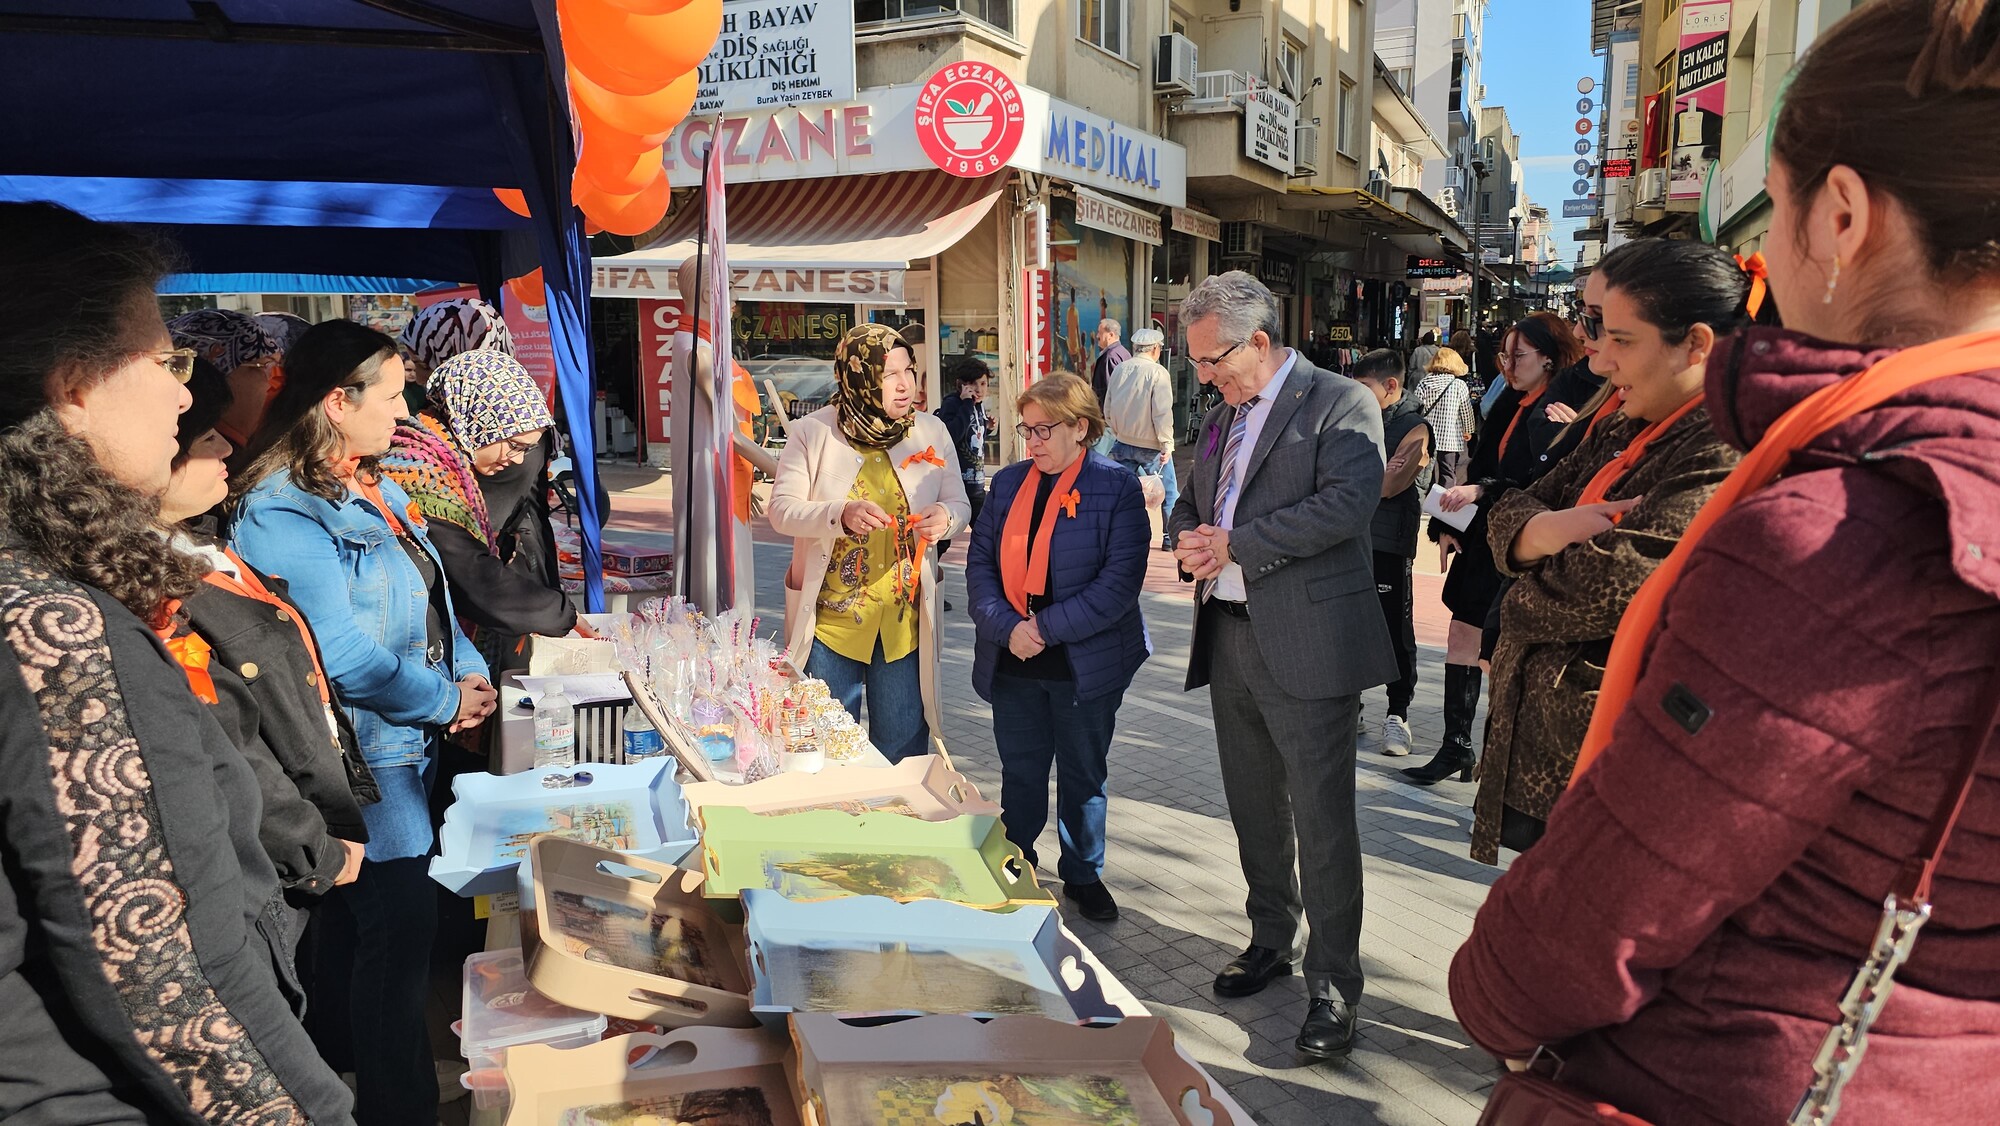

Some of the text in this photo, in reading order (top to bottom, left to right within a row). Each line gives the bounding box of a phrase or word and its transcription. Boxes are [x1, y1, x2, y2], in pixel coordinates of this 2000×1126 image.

[720, 2, 818, 34] H BAYAV
[722, 33, 757, 61] DİŞ
[762, 37, 809, 54] SAĞLIĞI
[1683, 39, 1724, 70] EN KALICI
[789, 76, 821, 89] HEKİMİ
[1679, 58, 1725, 90] MUTLULUK
[696, 86, 719, 98] EKİMİ
[700, 99, 725, 111] BAYAV
[757, 95, 779, 105] Burak
[802, 89, 833, 101] ZEYBEK
[917, 65, 1024, 127] ŞİFA ECZANESİ
[1048, 110, 1162, 189] MEDİKAL
[945, 154, 999, 173] 1968
[597, 267, 890, 293] İFA EZANESİ
[735, 314, 847, 340] CZANESİ
[1331, 328, 1348, 339] 250
